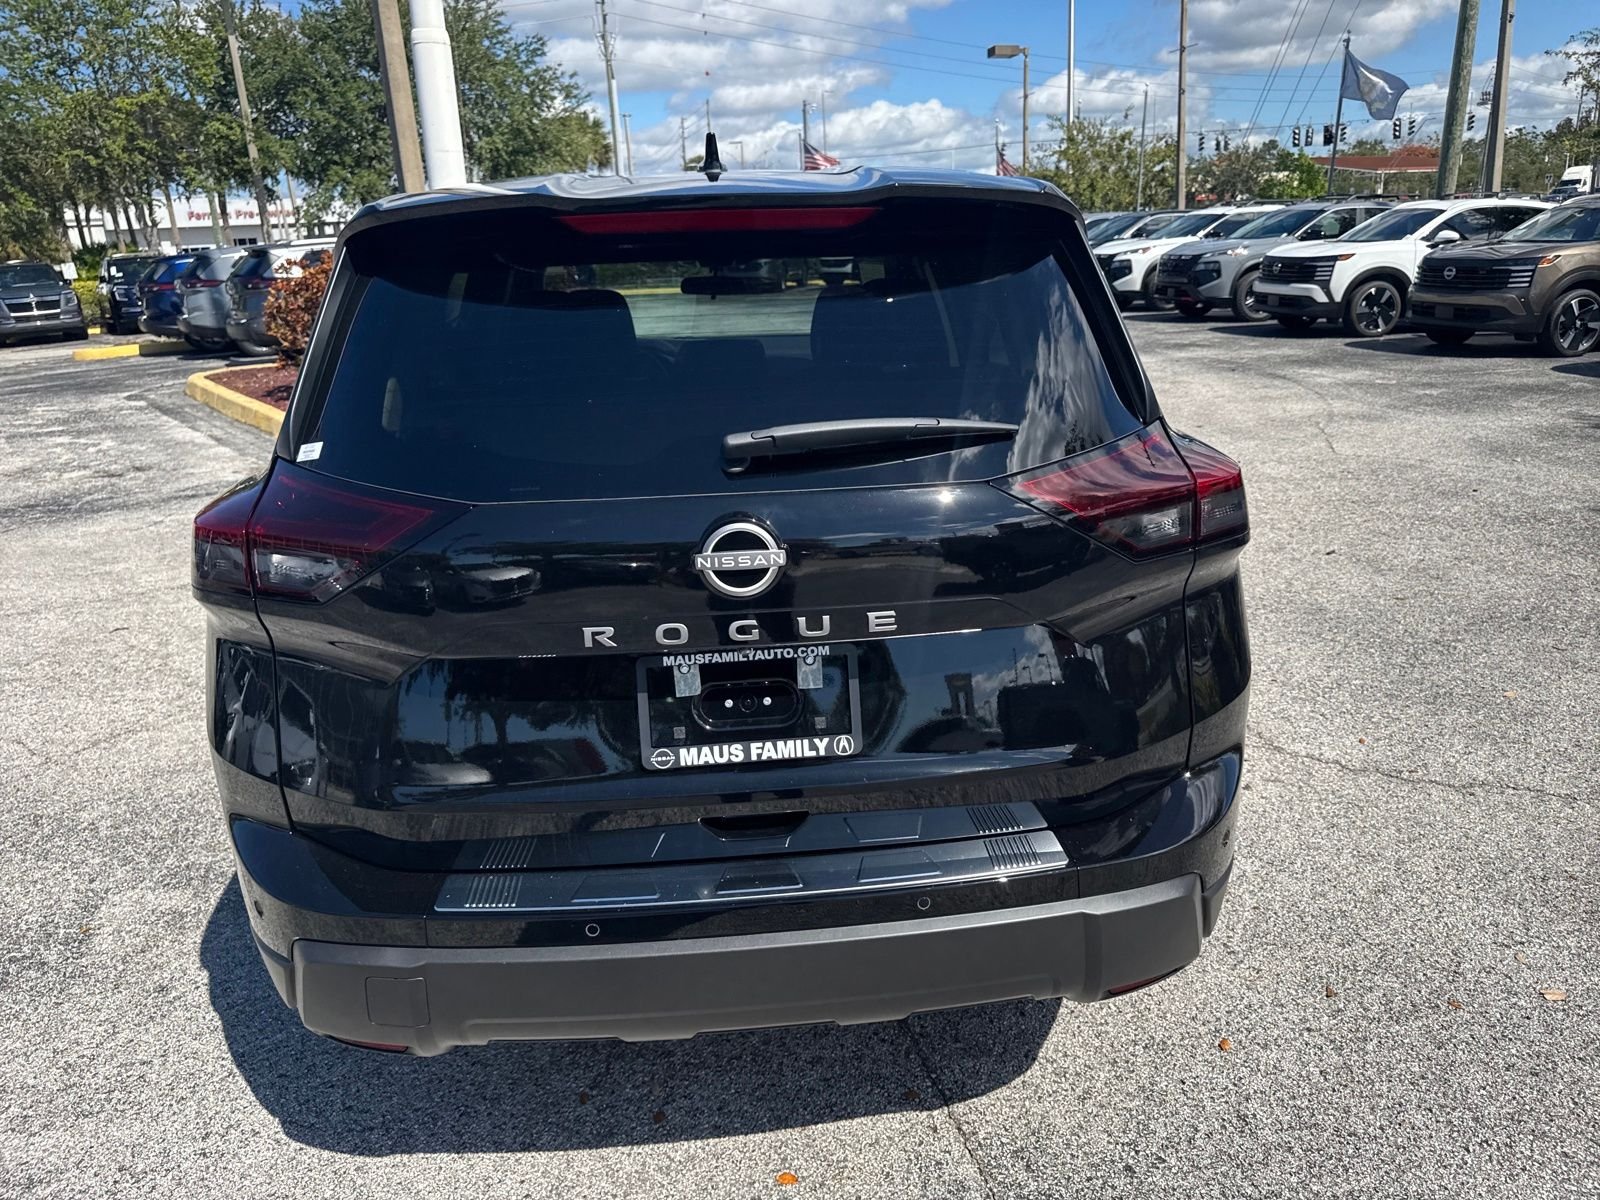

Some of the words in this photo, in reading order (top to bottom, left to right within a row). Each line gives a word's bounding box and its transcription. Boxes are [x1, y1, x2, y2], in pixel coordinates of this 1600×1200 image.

[696, 552, 785, 569] NISSAN
[582, 610, 898, 648] ROGUE
[662, 645, 830, 667] MAUSFAMILYAUTO.COM
[679, 744, 744, 767] MAUS
[750, 737, 829, 761] FAMILY
